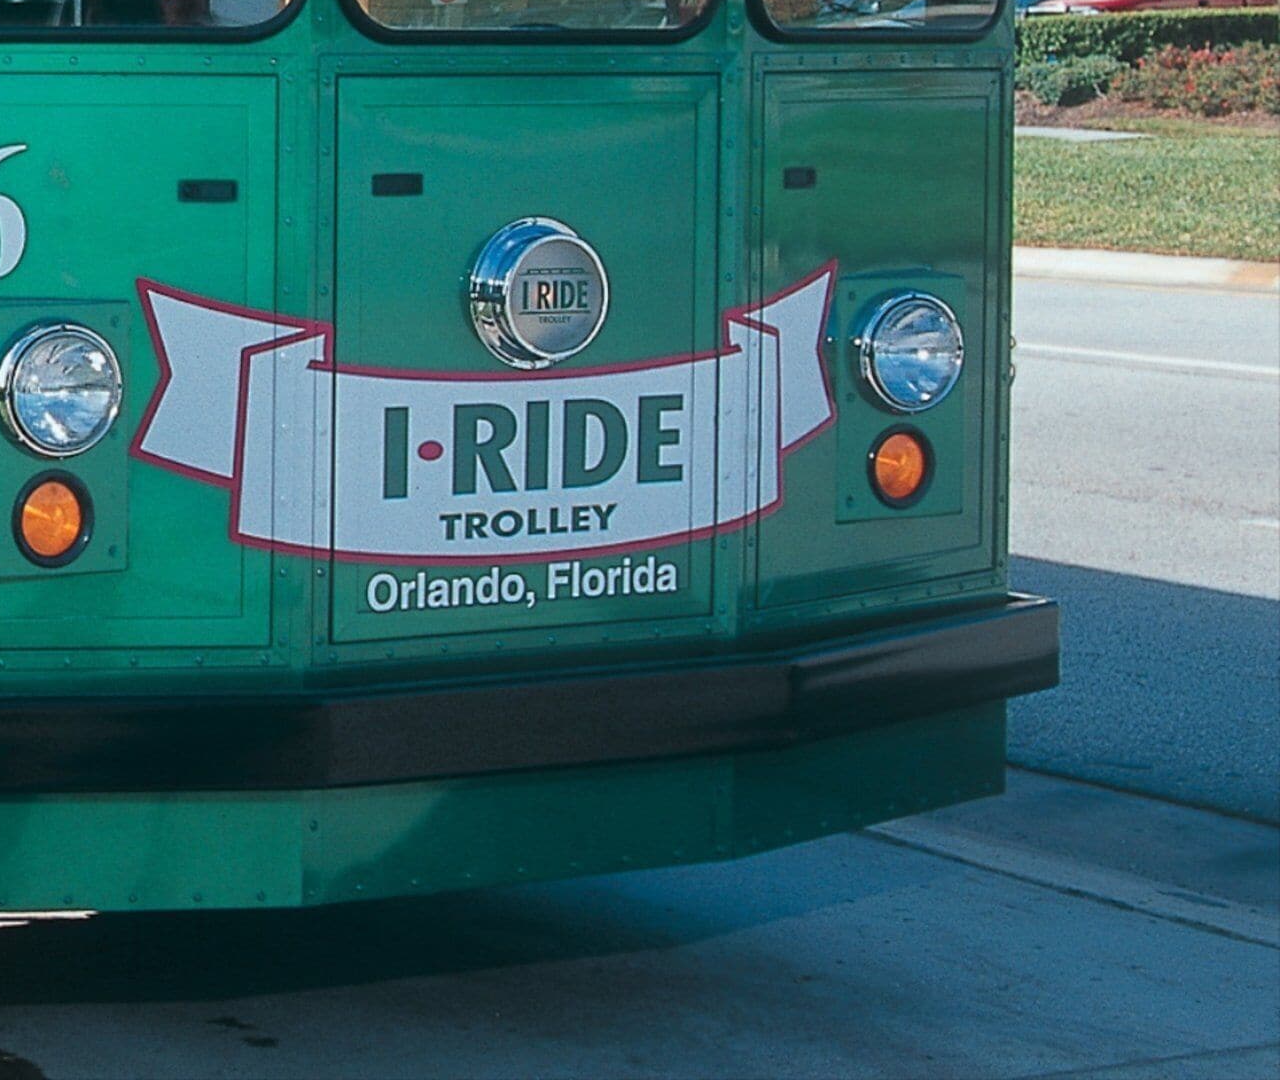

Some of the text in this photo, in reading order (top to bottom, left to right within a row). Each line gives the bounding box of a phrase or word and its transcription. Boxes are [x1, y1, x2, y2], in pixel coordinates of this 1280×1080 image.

[440, 503, 618, 541] TROLLEY
[366, 556, 678, 612] Orlando, Florida
